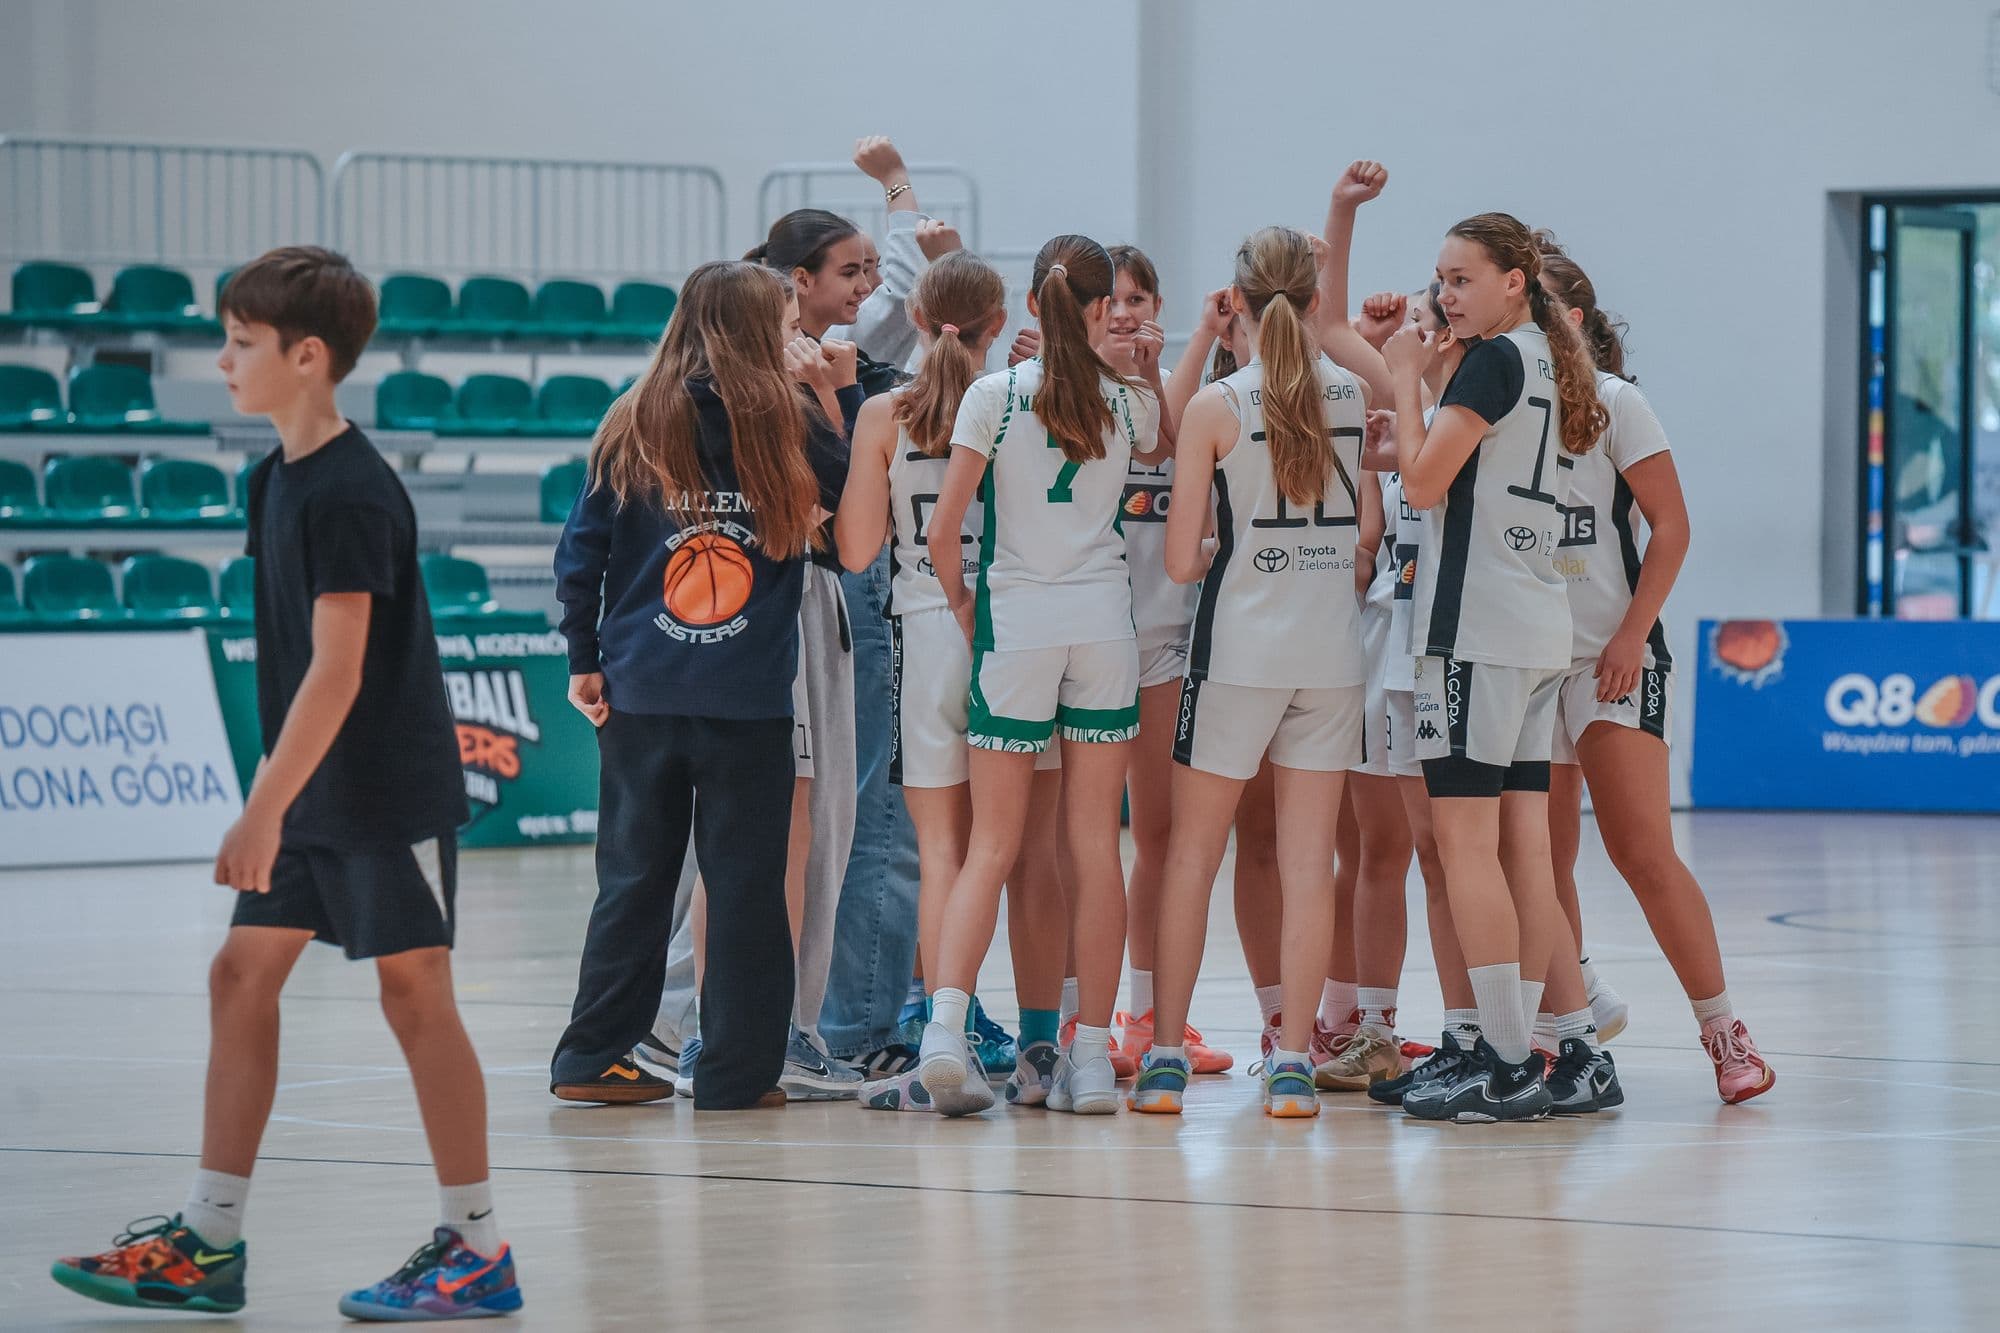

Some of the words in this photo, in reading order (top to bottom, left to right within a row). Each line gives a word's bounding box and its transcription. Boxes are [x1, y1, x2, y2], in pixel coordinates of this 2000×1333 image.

[1298, 545, 1336, 558] Toyota
[1298, 559, 1340, 571] Zielona
[653, 612, 749, 644] SISTERS
[443, 668, 541, 742] BALL
[1446, 678, 1462, 728] GÓRA
[1824, 673, 1916, 728] Q8
[0, 703, 169, 756] DOCIĄGI
[111, 753, 229, 807] GÓRA
